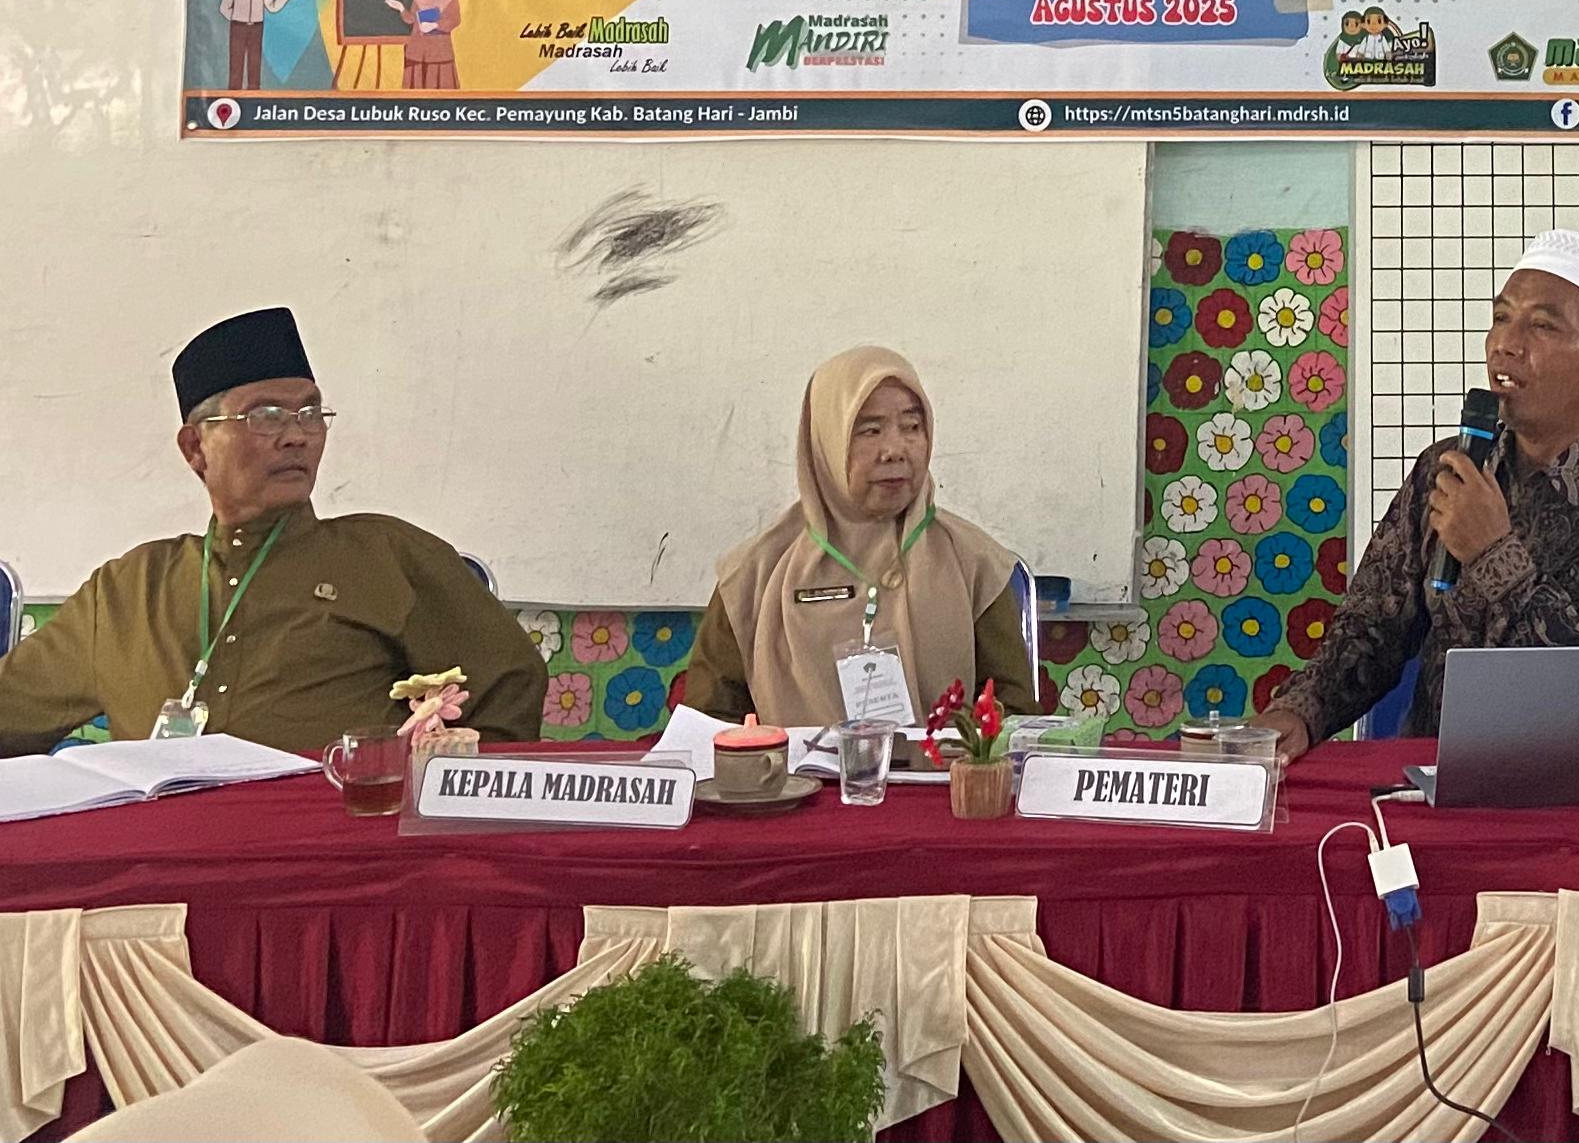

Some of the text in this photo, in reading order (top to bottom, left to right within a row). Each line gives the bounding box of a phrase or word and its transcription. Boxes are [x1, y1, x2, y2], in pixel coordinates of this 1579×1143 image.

[520, 22, 552, 39] Lebih
[588, 16, 669, 43] Madrasah
[808, 14, 888, 27] Madrasah
[746, 15, 890, 73] MANDIRI
[1392, 22, 1429, 51] Ayo!
[538, 43, 623, 58] Madrasah
[610, 58, 668, 73] Lebih Baik
[1340, 62, 1425, 75] MADRASAH
[254, 105, 299, 121] Jalan
[304, 106, 346, 121] Desa
[351, 105, 403, 121] Lubuk
[409, 107, 450, 121] Ruso
[456, 106, 491, 122] Kec.
[496, 106, 586, 124] Pemayung
[591, 105, 628, 121] Kab.
[634, 106, 693, 124] Batang
[698, 105, 733, 121] Hari
[748, 105, 799, 122] Jambi
[1065, 105, 1349, 125] https://mtsn5batanghari.mdrsh.id
[438, 769, 677, 805] KEPALA MADRASAH
[1073, 769, 1211, 807] PEMATERI
